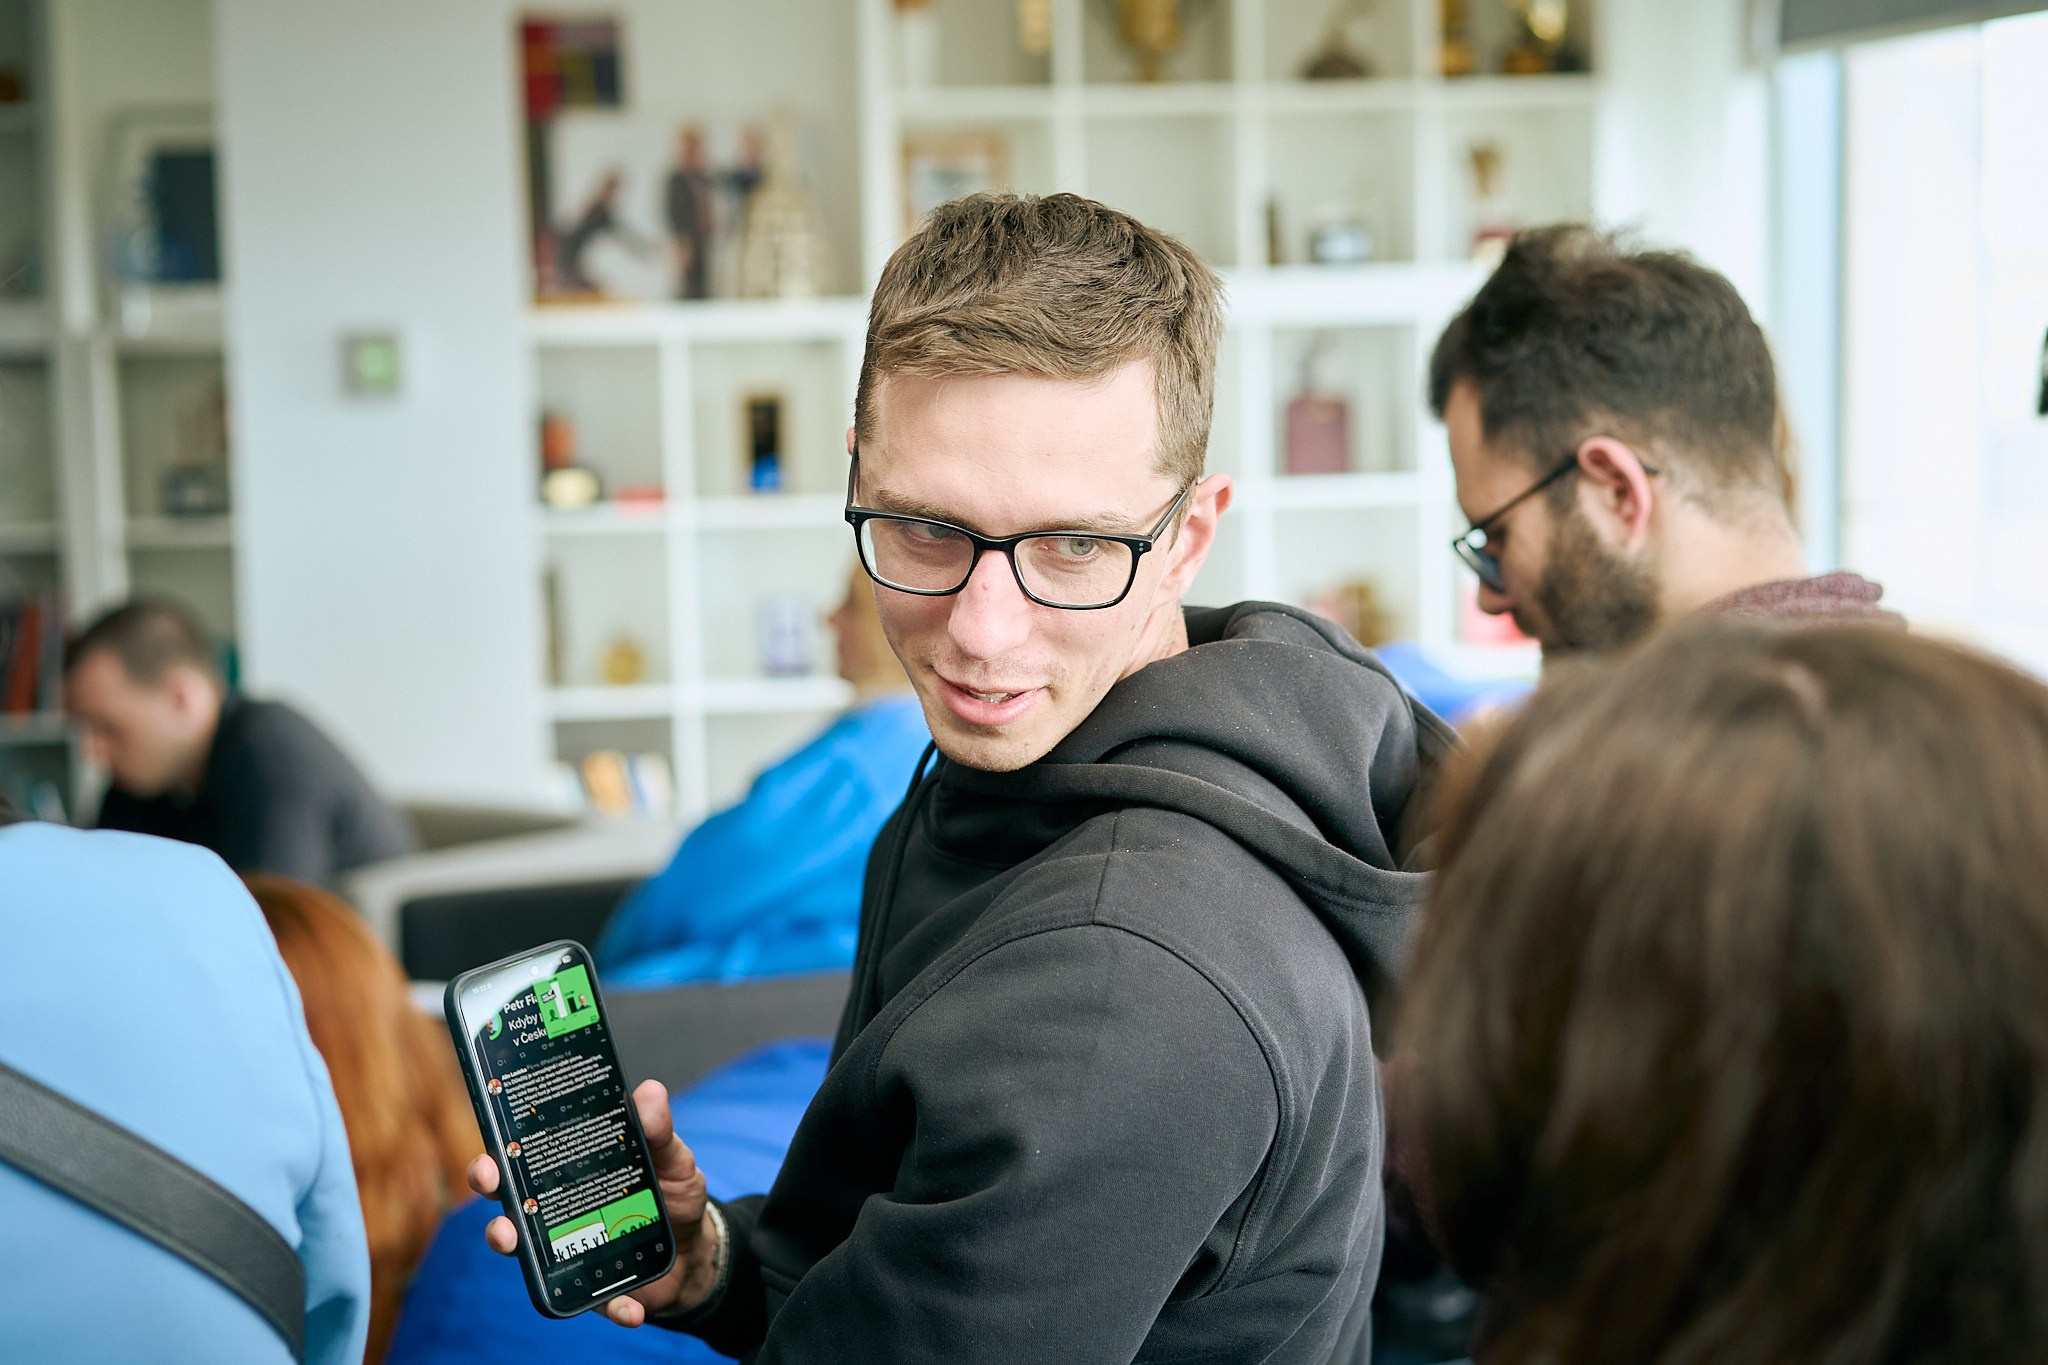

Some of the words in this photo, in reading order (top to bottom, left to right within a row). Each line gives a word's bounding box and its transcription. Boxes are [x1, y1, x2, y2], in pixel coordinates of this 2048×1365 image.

[504, 998, 524, 1014] Petr
[509, 1013, 538, 1030] Kdyby
[513, 1038, 520, 1046] v
